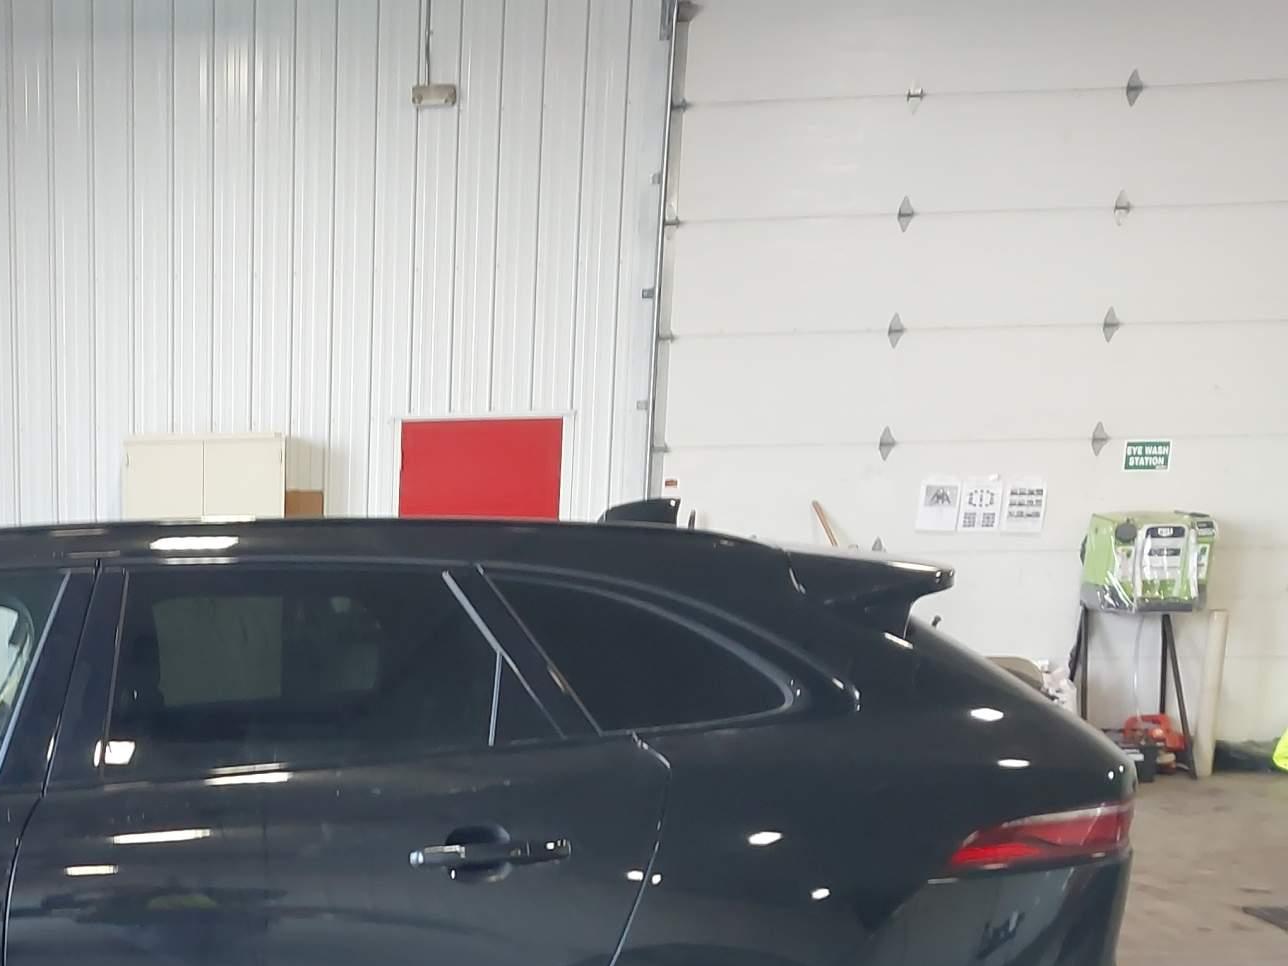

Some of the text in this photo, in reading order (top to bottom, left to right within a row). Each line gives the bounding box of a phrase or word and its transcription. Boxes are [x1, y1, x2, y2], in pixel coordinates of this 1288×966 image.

[1126, 445, 1169, 456] EYE WASH
[1128, 456, 1165, 467] STATION
